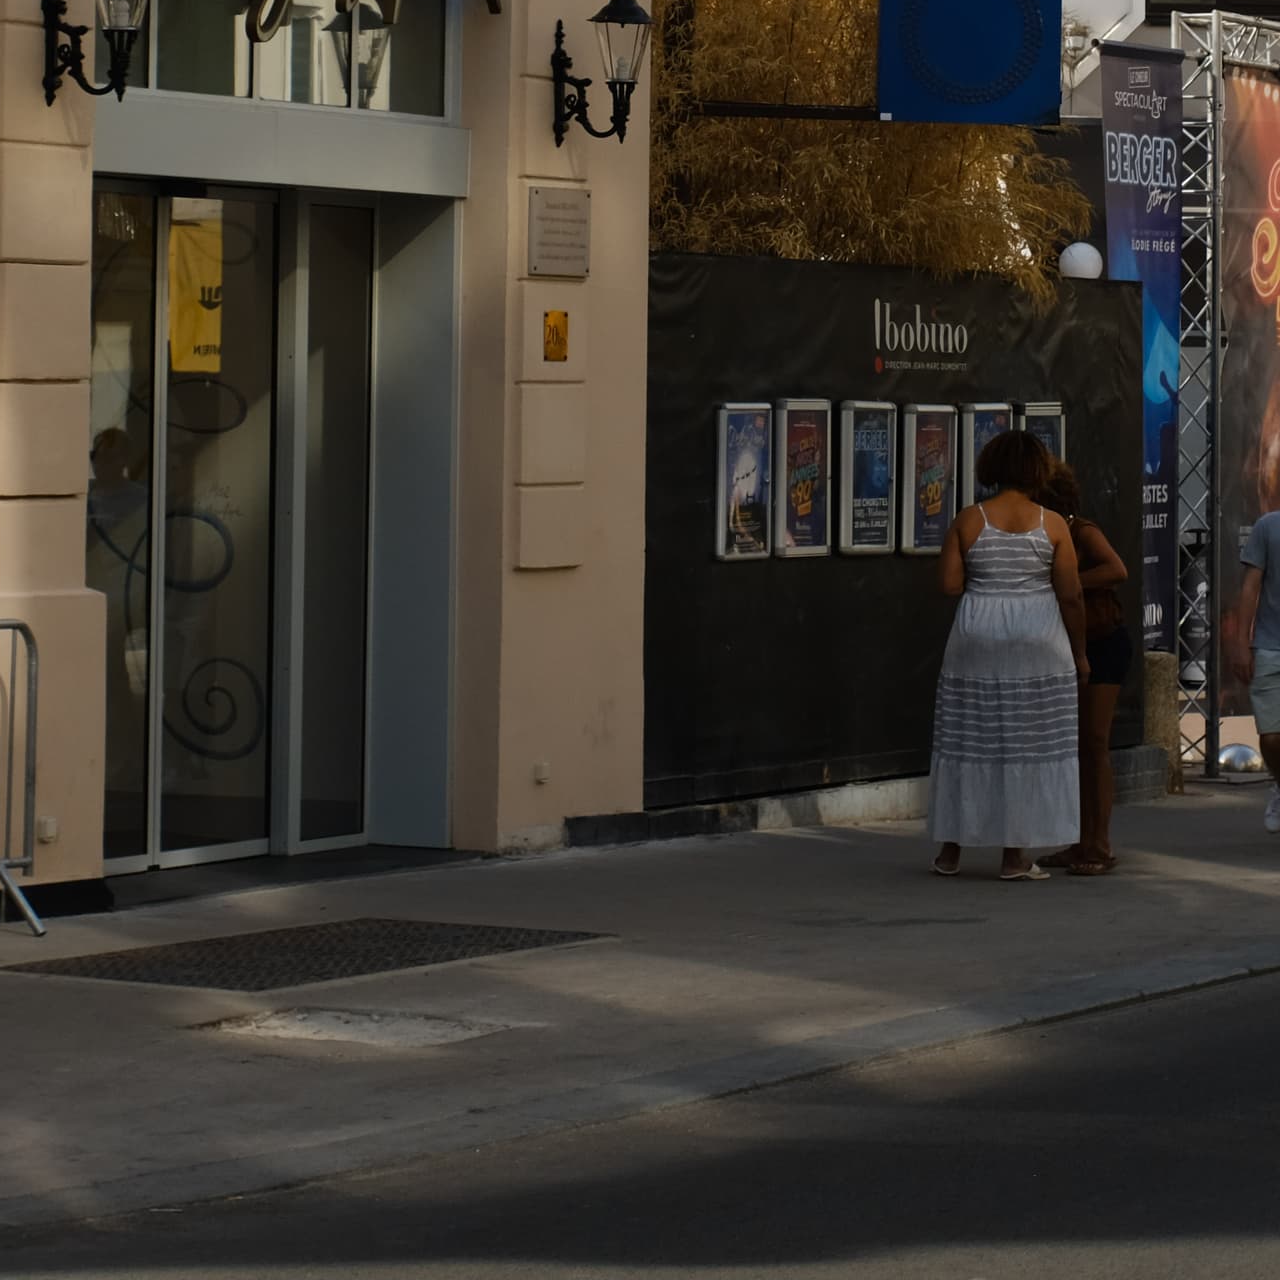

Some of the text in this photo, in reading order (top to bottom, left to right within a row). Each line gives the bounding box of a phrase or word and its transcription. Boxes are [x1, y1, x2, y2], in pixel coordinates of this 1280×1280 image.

[1106, 131, 1177, 187] BERGER
[855, 429, 888, 450] BERGER
[927, 481, 941, 504] 90
